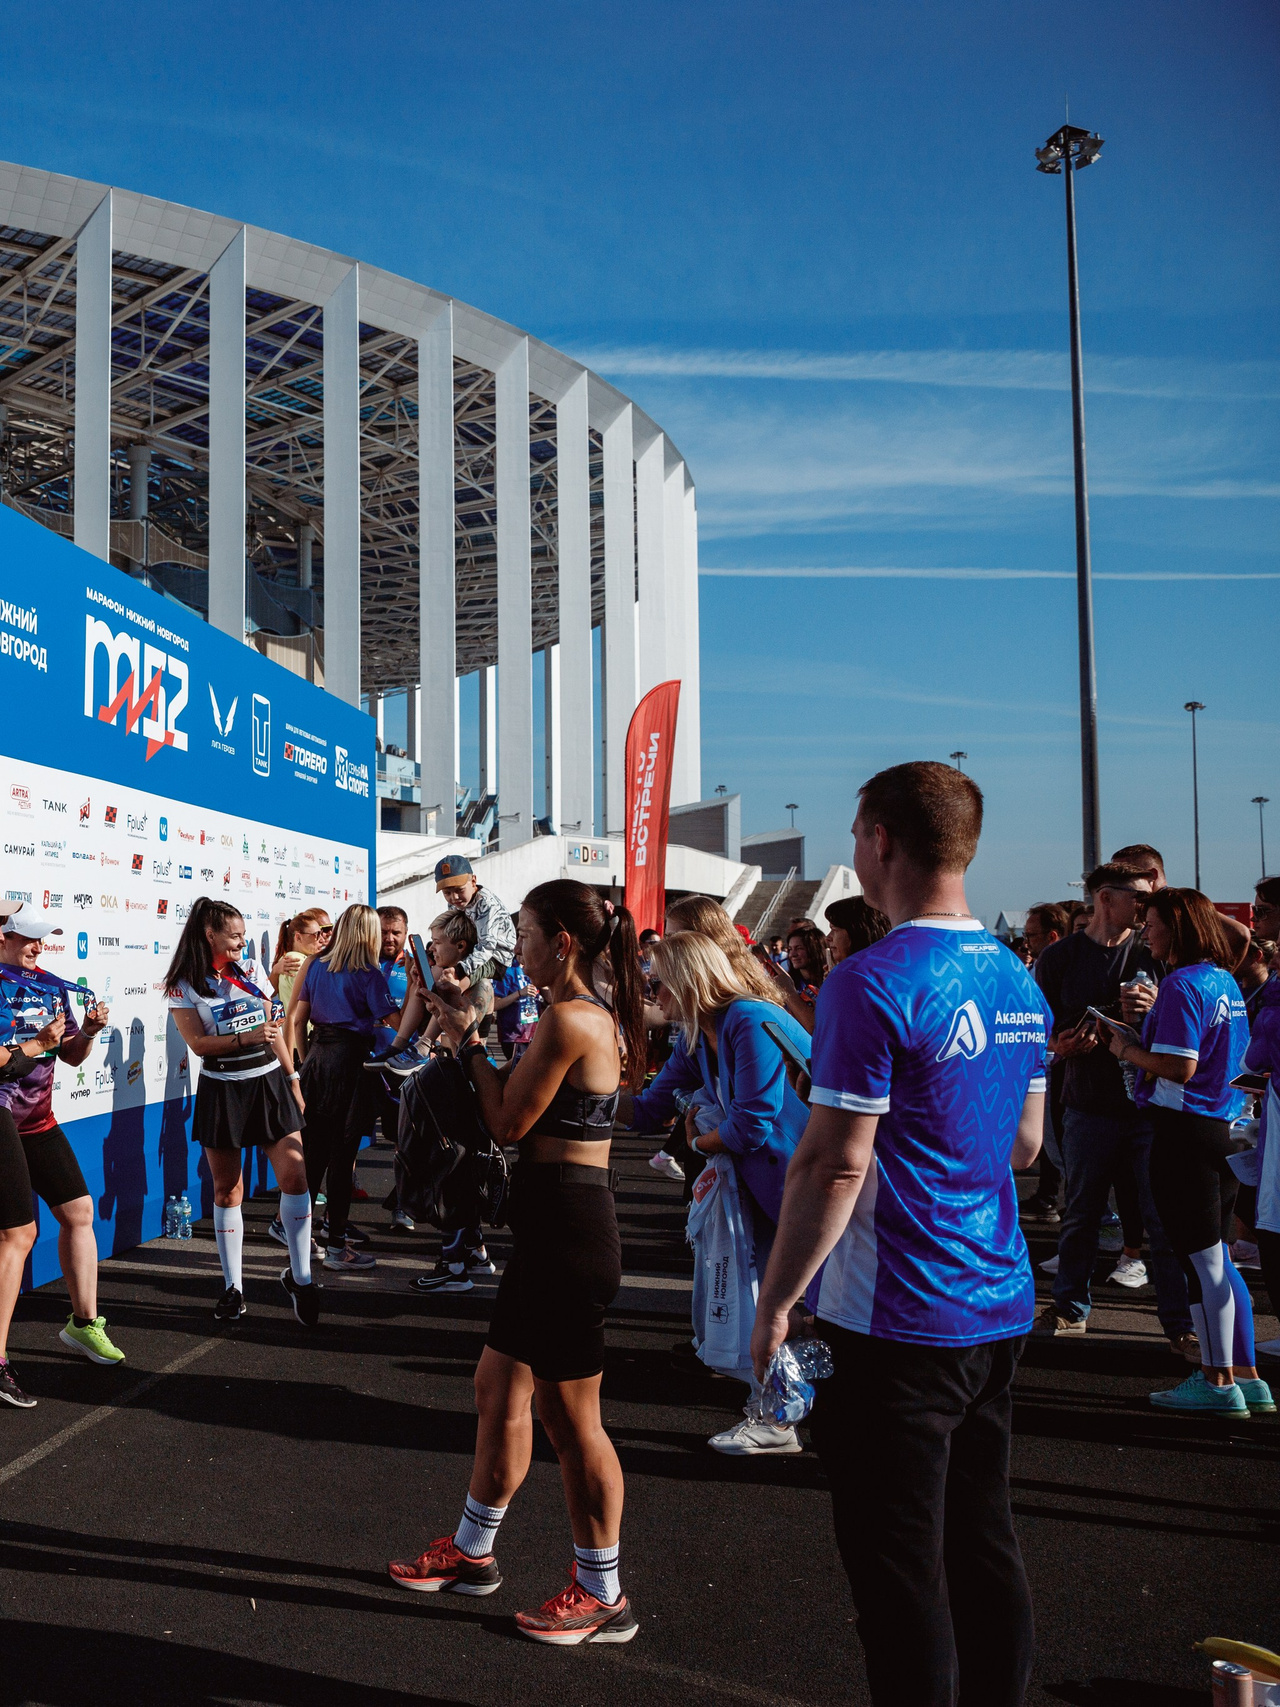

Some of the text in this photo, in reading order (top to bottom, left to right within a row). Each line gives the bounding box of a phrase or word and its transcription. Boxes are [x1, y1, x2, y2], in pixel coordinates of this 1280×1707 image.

[86, 586, 190, 653] МАРАФОН НИЖНИЙ НОВГОРОД
[255, 757, 269, 769] TANK
[294, 745, 328, 775] TORERO
[11, 787, 29, 799] ARTRA
[348, 776, 369, 799] СПОРТЕ
[42, 799, 68, 813] TANK
[127, 813, 145, 833] Fplus
[4, 842, 36, 857] САМУРАЙ
[582, 846, 590, 863] D
[152, 860, 169, 878] Fplus
[50, 893, 64, 903] СПОРТ
[73, 893, 93, 906] МАГУРО
[100, 895, 119, 909] ОКА
[98, 936, 120, 947] VITRUM
[124, 982, 147, 996] САМУРАЙ
[225, 1015, 257, 1030] 7738
[125, 1025, 145, 1036] TANK
[95, 1070, 115, 1089] Fplus
[70, 1088, 91, 1101] купер
[713, 1262, 722, 1299] НИЖНИЙ
[721, 1256, 730, 1300] НОВГОРОД
